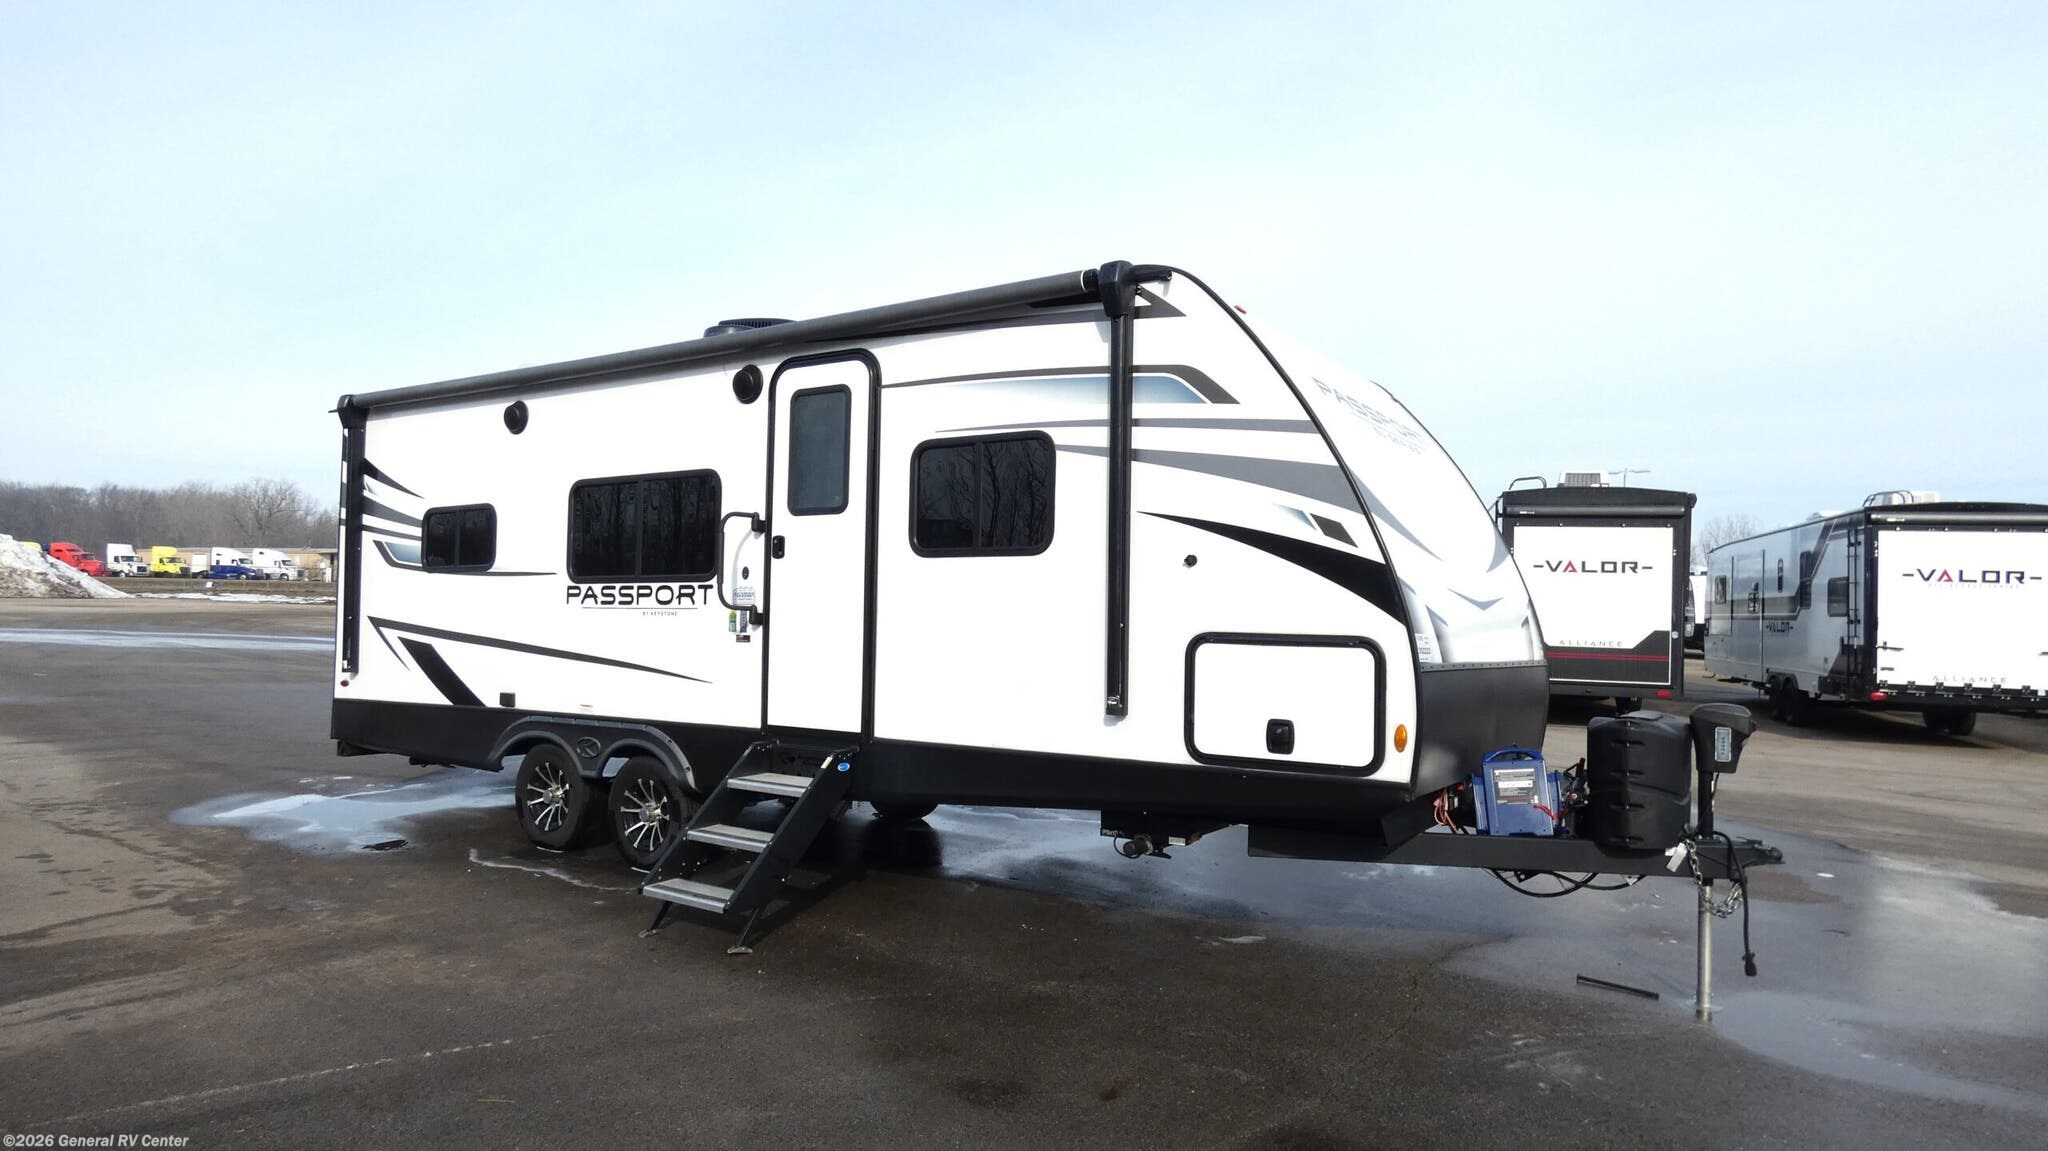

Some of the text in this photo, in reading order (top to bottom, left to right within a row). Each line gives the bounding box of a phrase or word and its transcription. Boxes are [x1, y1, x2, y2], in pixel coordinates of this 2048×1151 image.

[566, 584, 714, 606] PASSPORT
[1559, 639, 1624, 648] ALLIANCE
[1932, 675, 2007, 684] ALLIANCE
